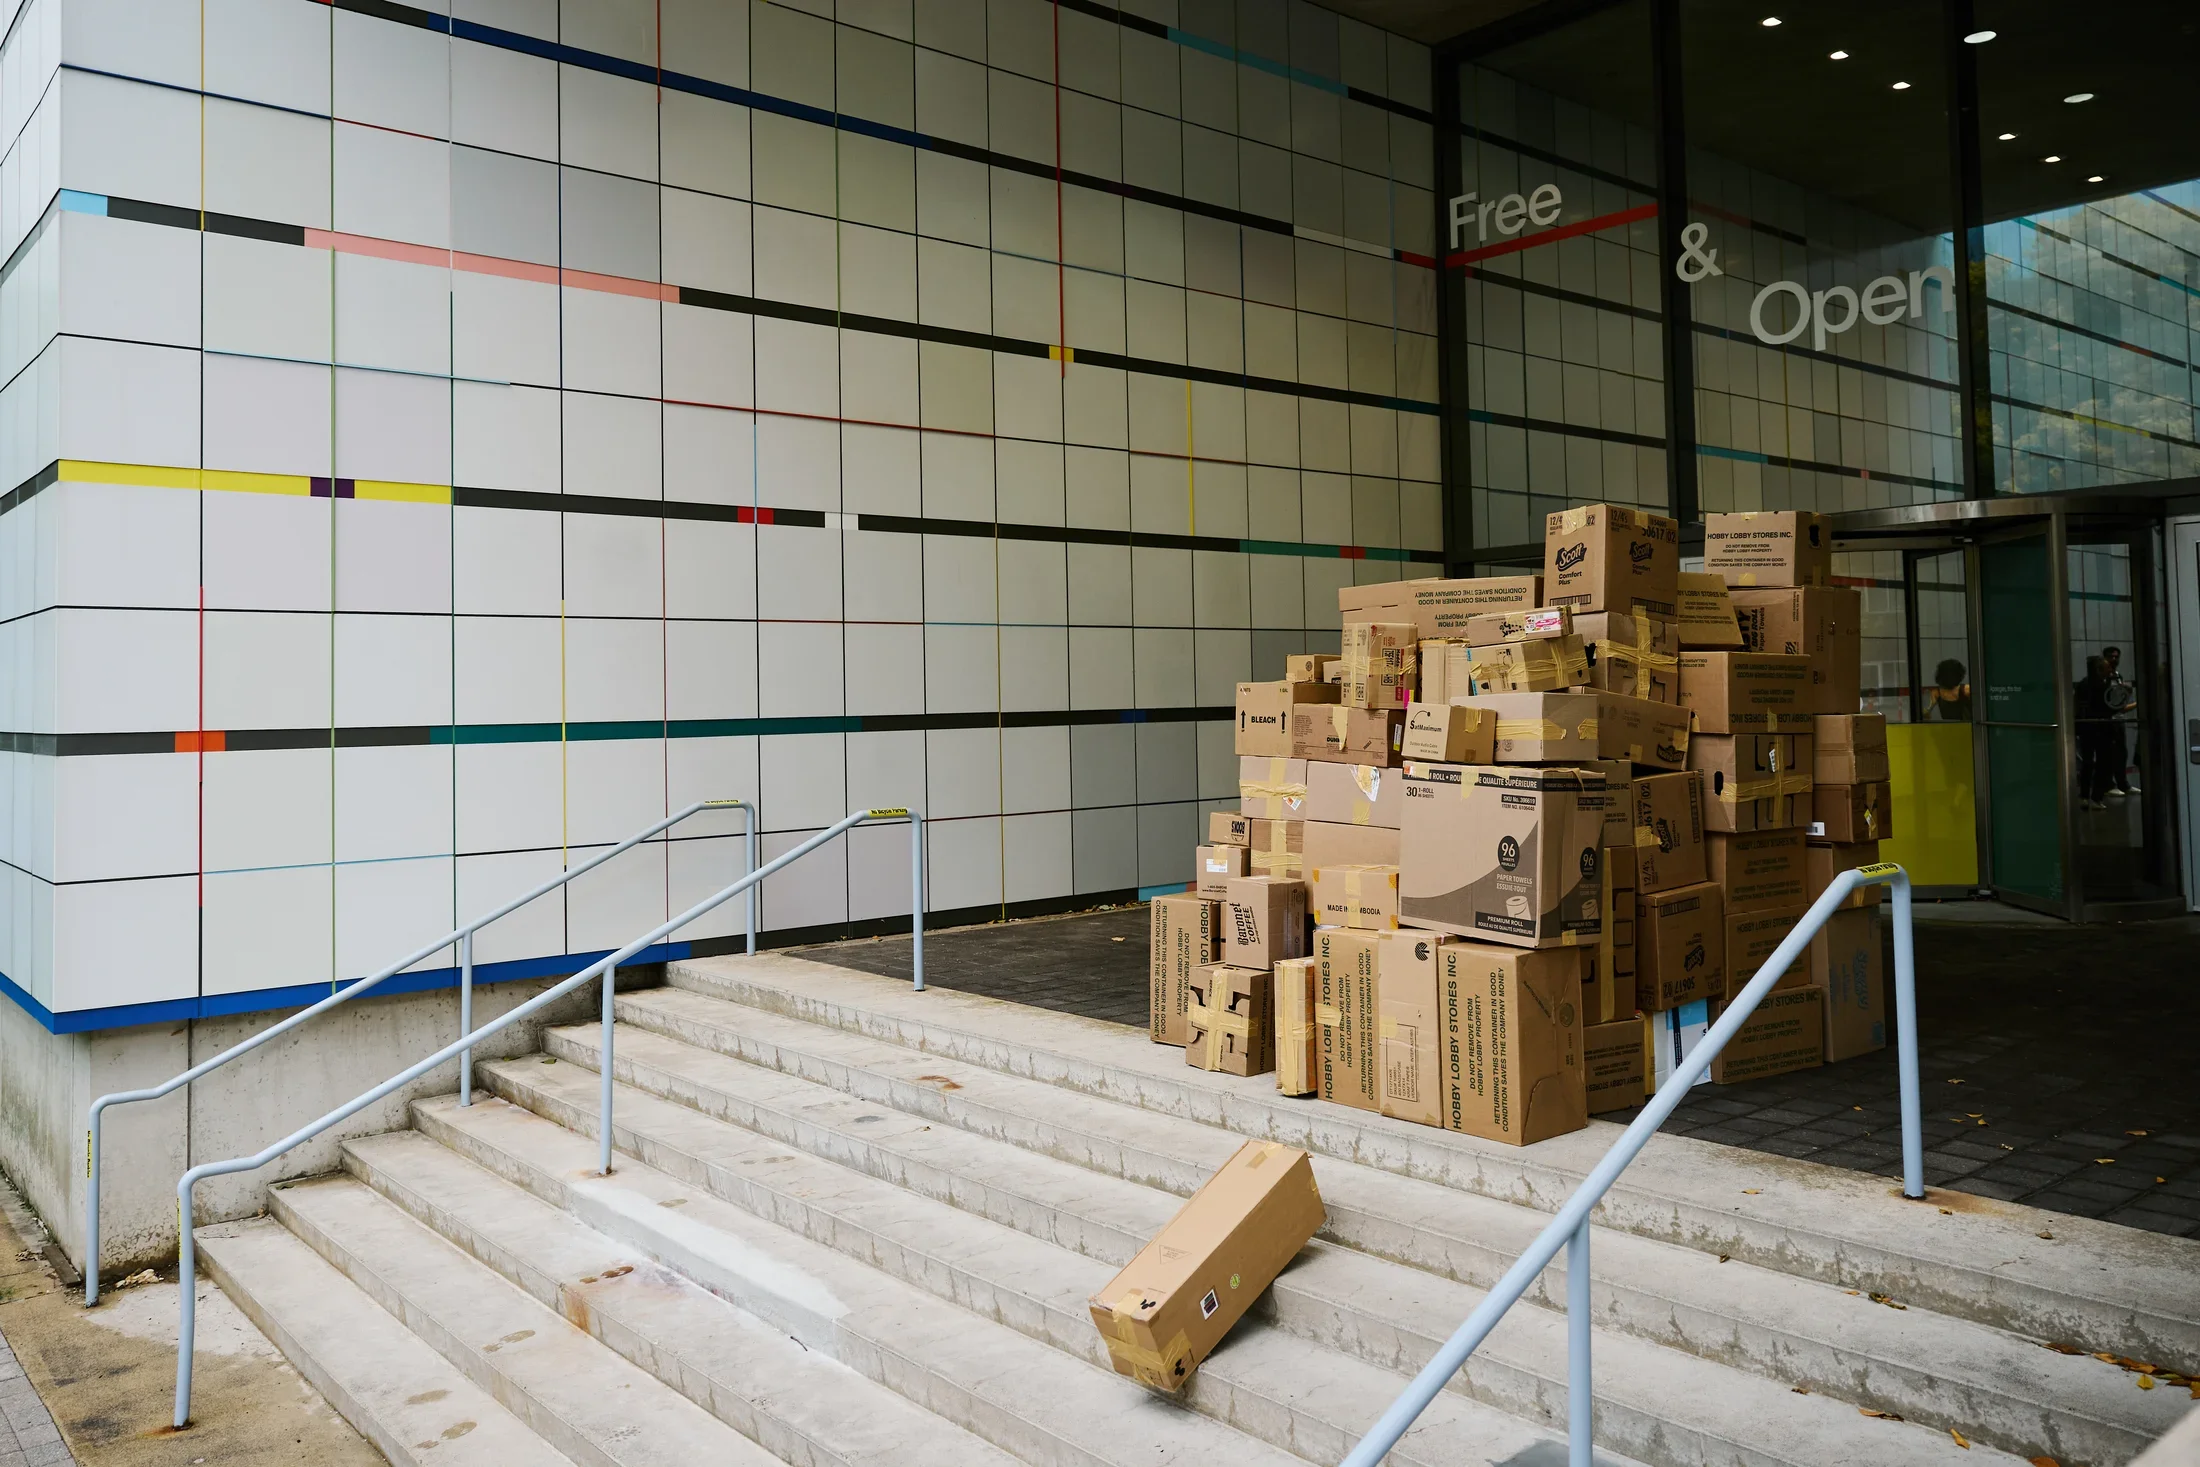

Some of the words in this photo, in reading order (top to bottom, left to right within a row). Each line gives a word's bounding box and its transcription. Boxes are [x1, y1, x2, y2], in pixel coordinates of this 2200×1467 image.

[1449, 184, 1563, 249] Free
[1675, 222, 1724, 283] &
[1749, 265, 1955, 352] Open
[1707, 532, 1729, 540] HOBBY
[1559, 543, 1586, 567] Scott
[1632, 543, 1651, 559] Scott
[1558, 571, 1582, 579] Comfort
[1251, 716, 1276, 724] BLEACH
[1729, 714, 1743, 723] INC.
[1744, 714, 1768, 723] STORES
[1791, 714, 1811, 722] HOBBY
[1410, 720, 1442, 732] SatMaximum
[1505, 778, 1537, 789] SUPÉRIEURE
[1406, 786, 1417, 797] 30
[1641, 785, 1650, 797] 02
[1656, 823, 1671, 849] Scott
[1501, 842, 1516, 857] 96
[1583, 854, 1594, 867] 96
[1496, 873, 1512, 881] PAPER
[1513, 875, 1533, 884] TOWELS
[1496, 883, 1527, 893] ESSUIE-TOUT
[1327, 904, 1343, 912] MADE
[1201, 904, 1209, 941] HOBBY
[1229, 903, 1249, 946] Baronet
[1242, 907, 1256, 943] COFFEE
[1487, 916, 1510, 924] PREMIUM
[1184, 933, 1190, 944] DO
[1322, 934, 1330, 958] INC.
[1447, 952, 1456, 978] INC.
[1322, 961, 1331, 1006] STORES
[1359, 977, 1364, 985] IN
[1491, 998, 1497, 1007] IN
[1776, 993, 1805, 1007] STORES
[1448, 981, 1458, 1033] STORES
[1491, 1008, 1499, 1056] CONTAINER
[1753, 1024, 1763, 1032] NOT
[1760, 1032, 1776, 1040] LOBBY
[1777, 1028, 1803, 1037] PROPERTY
[1340, 1050, 1345, 1062] DO
[1450, 1036, 1460, 1080] LOBBY
[1757, 1055, 1769, 1063] THIS
[1770, 1050, 1797, 1061] CONTAINER
[1752, 1064, 1769, 1072] SAVES
[1780, 1058, 1804, 1067] COMPANY
[1324, 1056, 1333, 1100] HOBBY
[1470, 1077, 1476, 1089] DO
[1610, 1078, 1626, 1088] LOBBY
[1627, 1075, 1644, 1084] HOBBY
[1588, 1081, 1609, 1092] STORES
[1452, 1084, 1461, 1130] HOBBY
